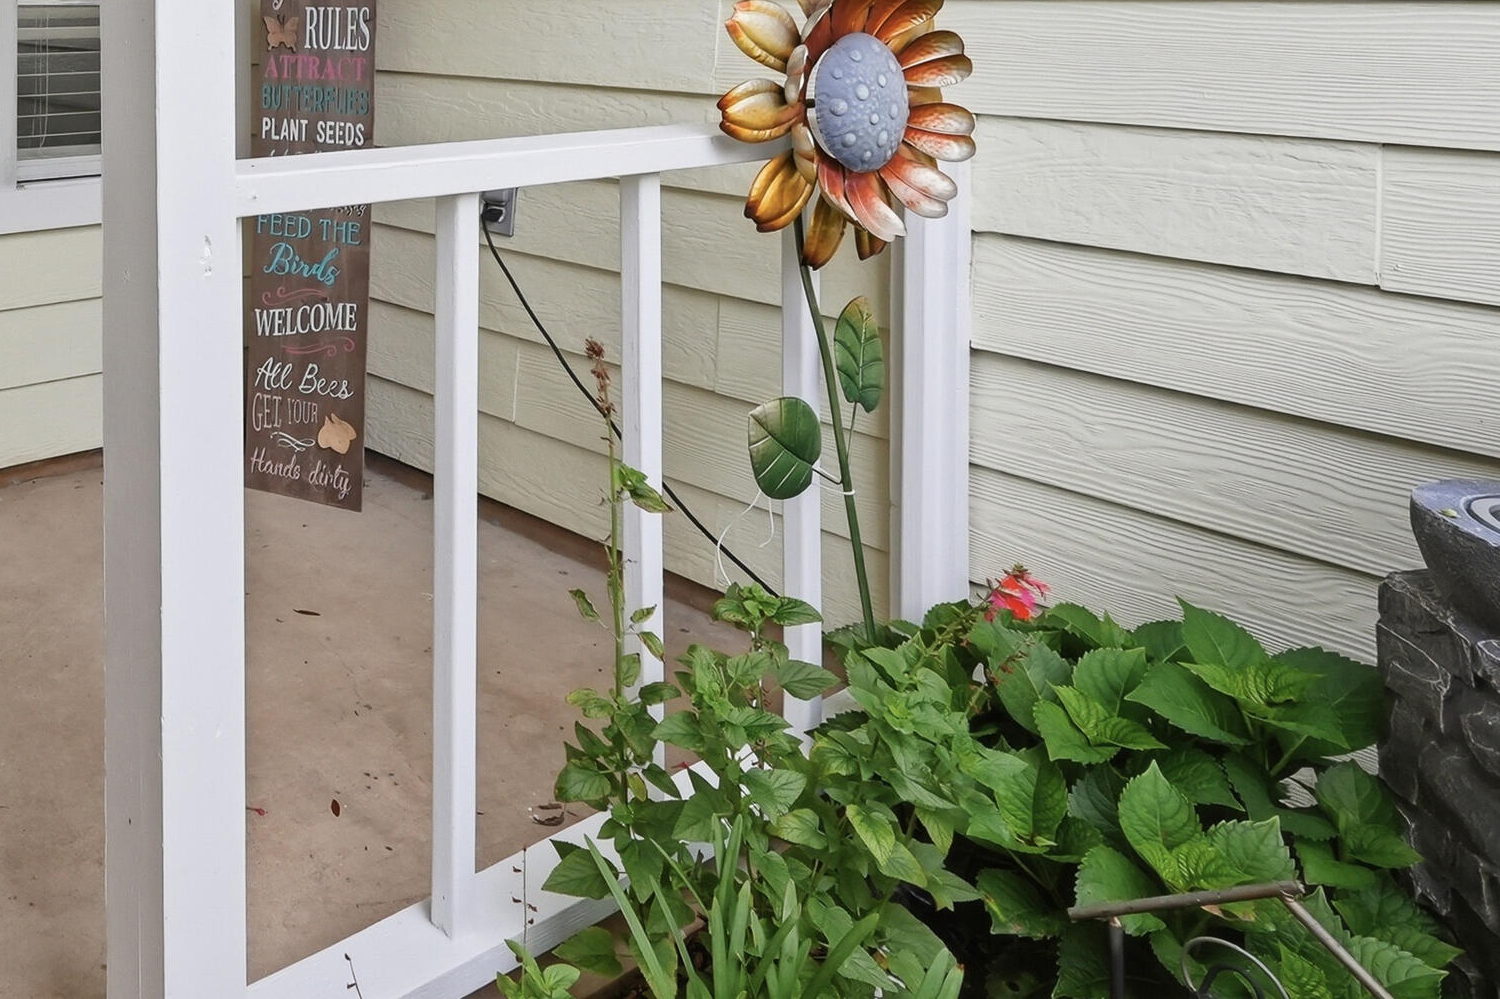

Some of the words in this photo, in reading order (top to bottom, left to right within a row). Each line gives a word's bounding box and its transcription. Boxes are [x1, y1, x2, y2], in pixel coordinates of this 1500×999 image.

[303, 6, 371, 51] RULES
[263, 54, 367, 82] ATTRACT
[261, 83, 370, 116] BUTTERFLIES
[261, 116, 308, 142] PLANT
[315, 120, 365, 146] SEEDS
[256, 213, 312, 239] FEED
[319, 218, 362, 246] THE
[263, 242, 341, 287] Birds
[254, 303, 358, 337] WELCOME
[254, 356, 293, 390] All
[298, 363, 354, 400] Bees
[252, 392, 282, 432] GET
[286, 397, 319, 426] YOUR
[250, 446, 301, 480] Hands
[308, 459, 351, 500] dirty
